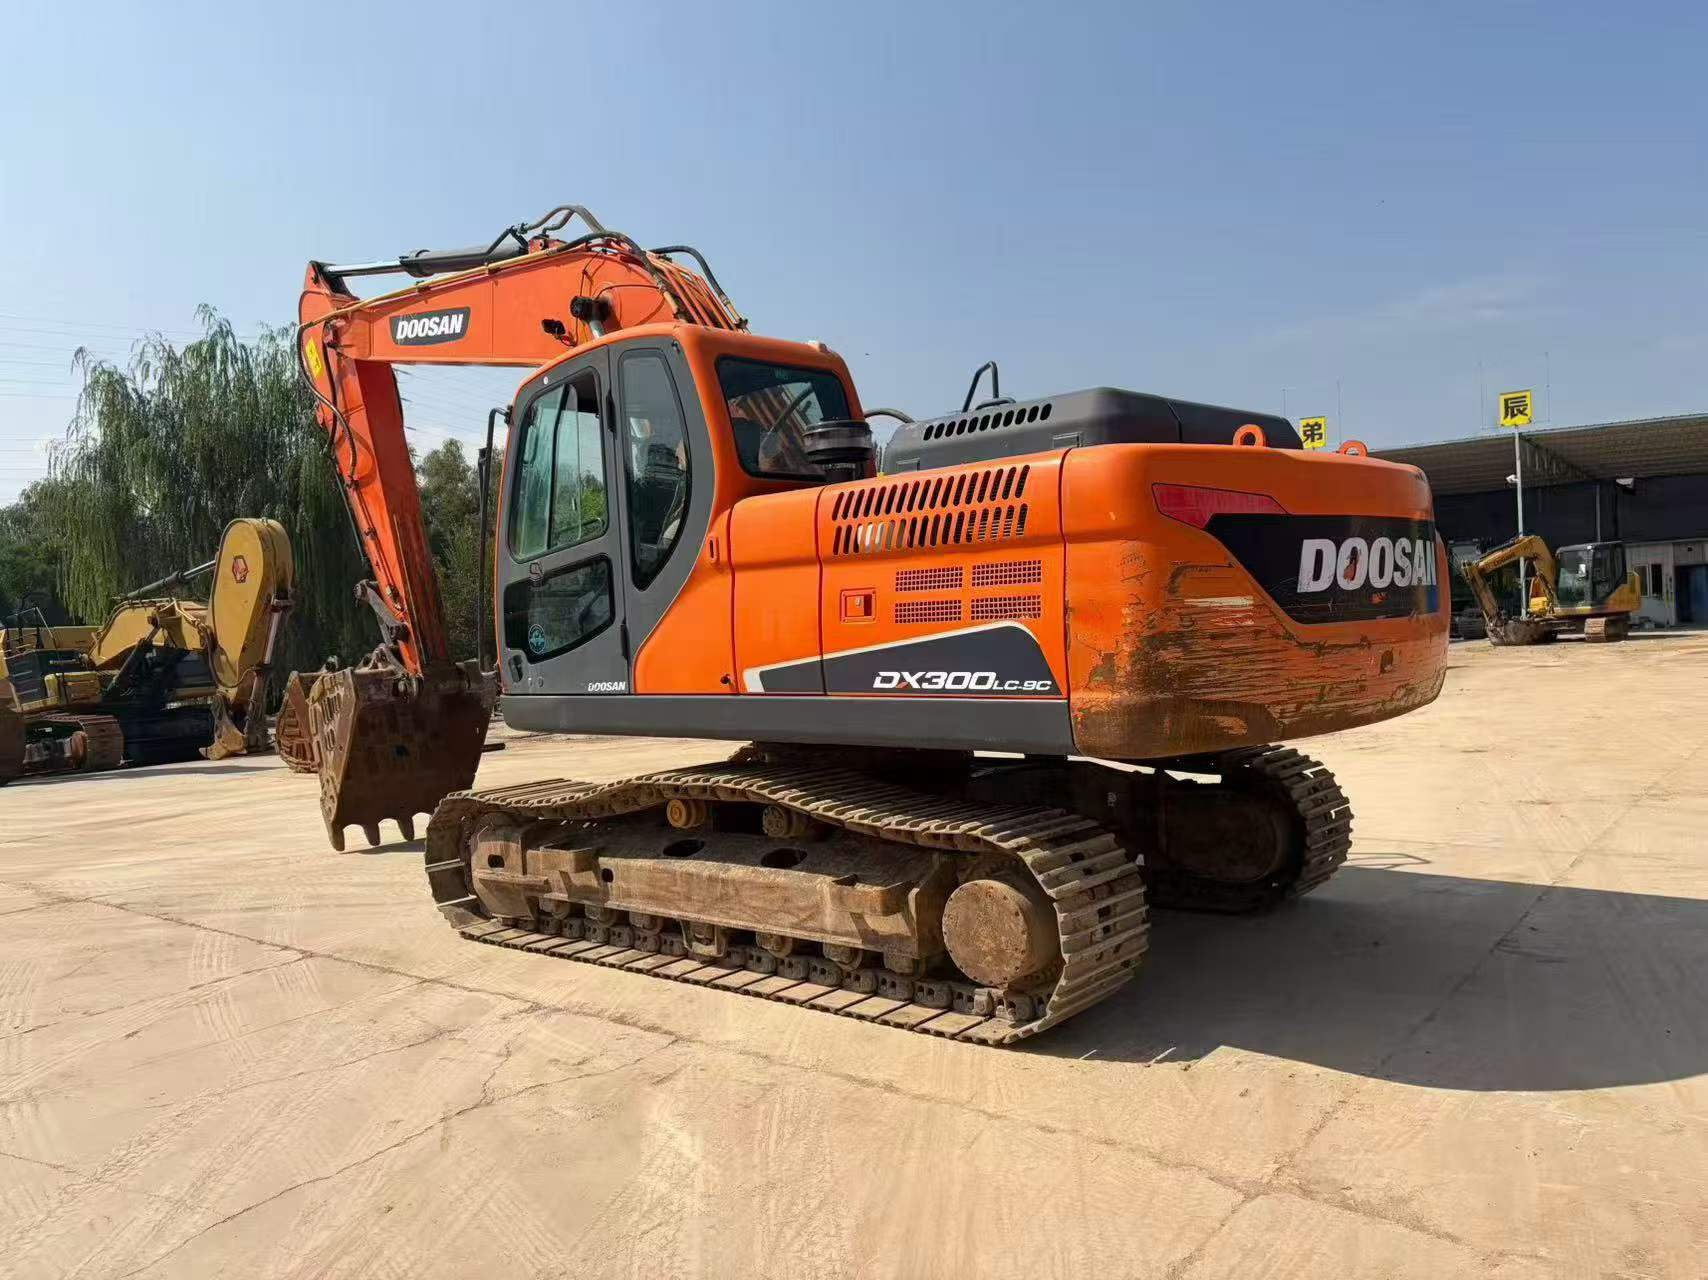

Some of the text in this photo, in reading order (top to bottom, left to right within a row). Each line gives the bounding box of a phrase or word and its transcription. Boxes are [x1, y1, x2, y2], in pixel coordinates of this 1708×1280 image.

[396, 313, 464, 340] DOOSAN
[1503, 396, 1528, 419] 辰
[1302, 421, 1323, 443] 弟
[1296, 536, 1437, 593] DOOSAN
[588, 681, 626, 692] DOOSAN
